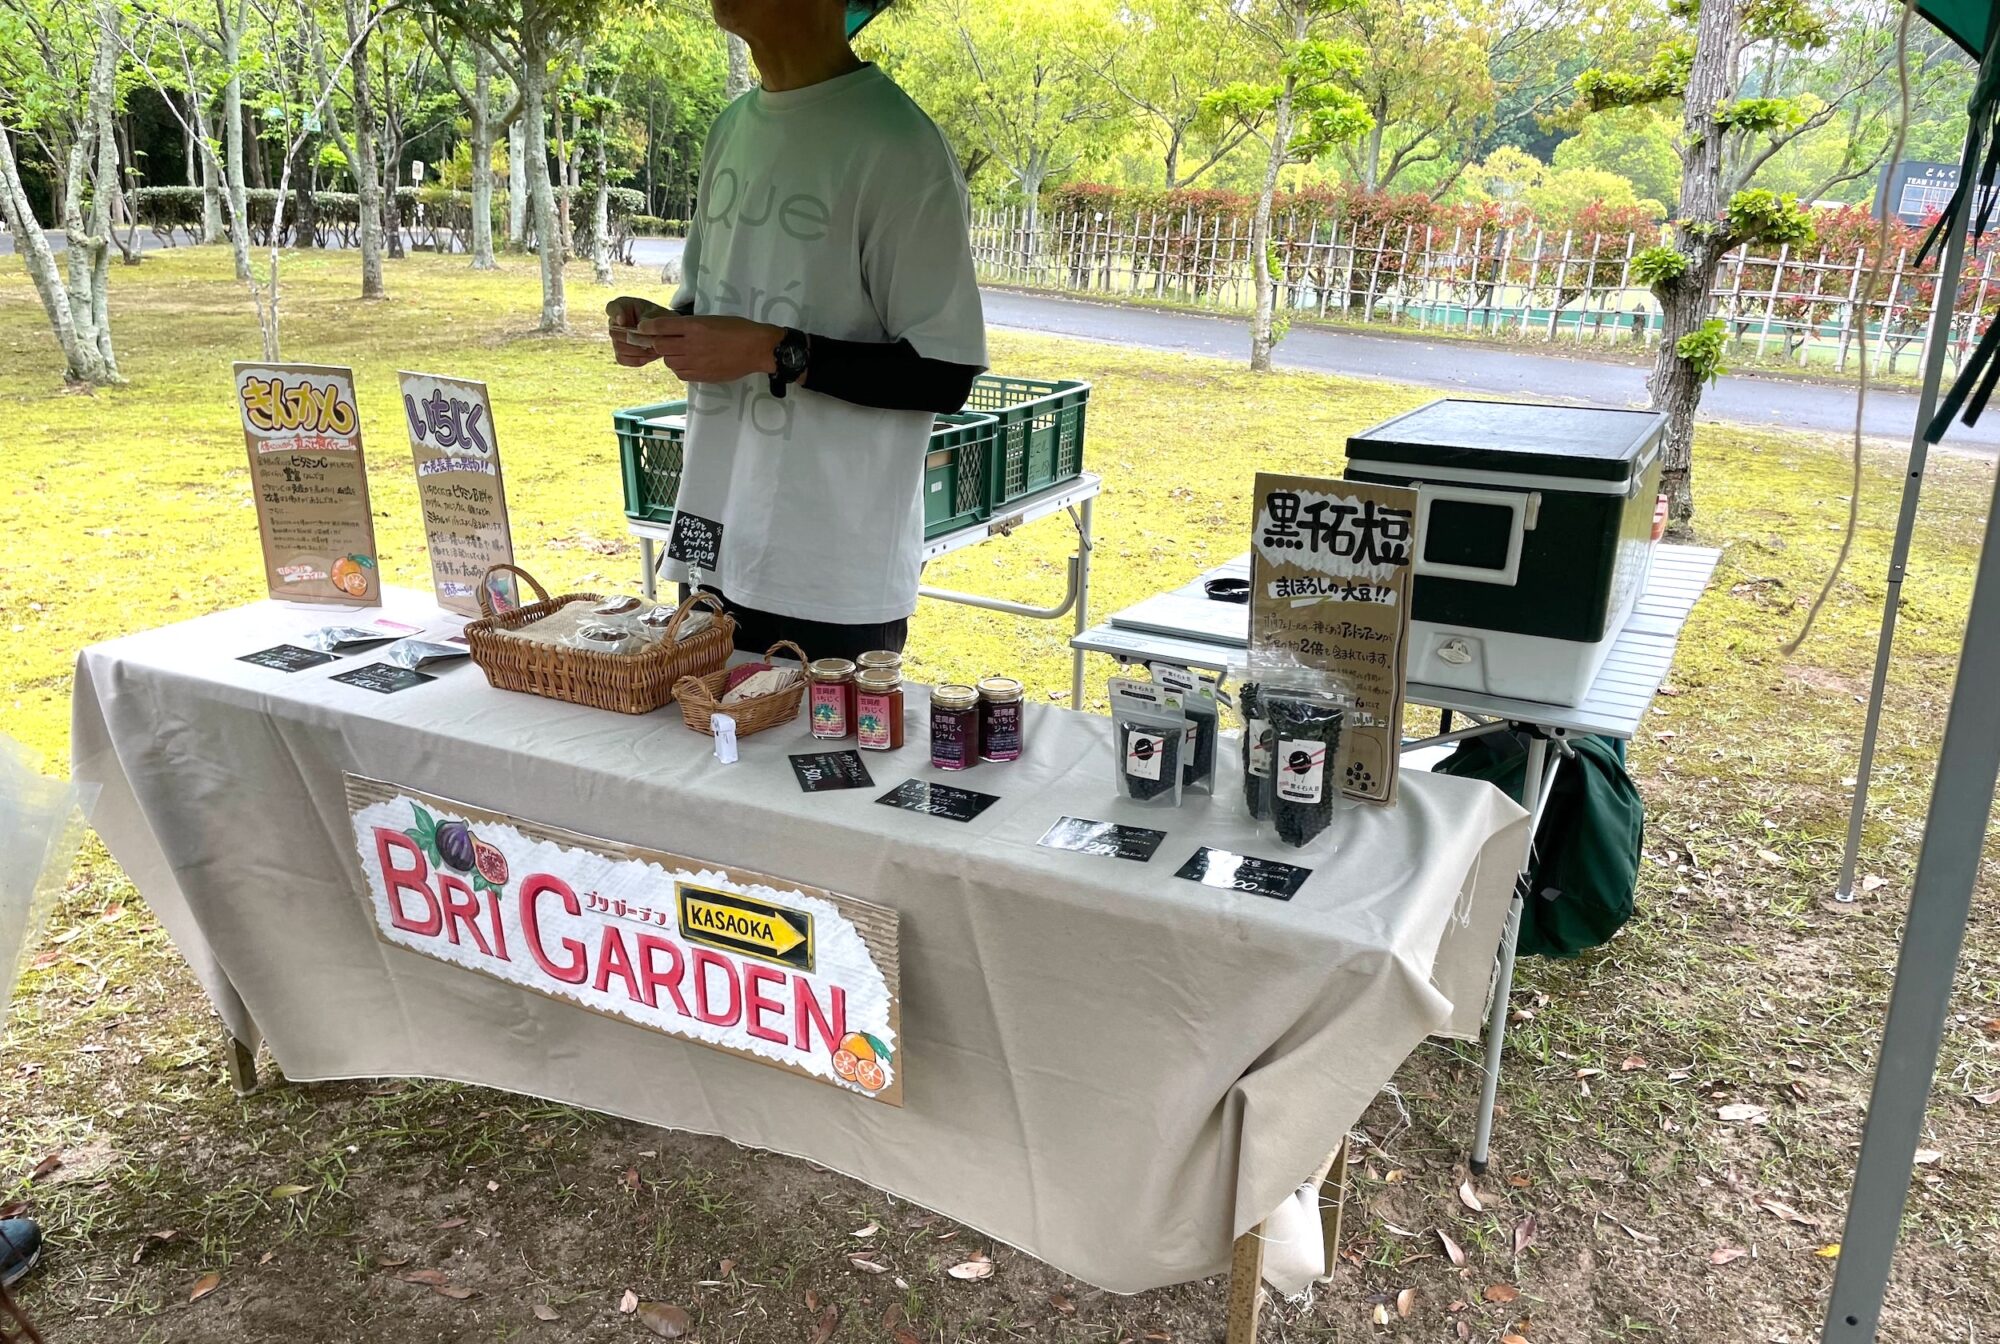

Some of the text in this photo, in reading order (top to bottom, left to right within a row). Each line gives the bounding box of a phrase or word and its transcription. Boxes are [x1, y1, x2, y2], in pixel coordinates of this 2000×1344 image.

[242, 376, 356, 435] きんかん
[405, 389, 487, 453] いちじく
[1264, 492, 1412, 566] 黒千石大豆
[685, 548, 715, 562] 200円
[1276, 576, 1391, 603] まぼろしの大豆!!
[993, 708, 1016, 717] 笠岡産
[994, 725, 1015, 733] ジャム
[935, 731, 956, 741] ジャム
[584, 891, 667, 926] ブリガーデン
[691, 905, 775, 942] KASAOKA
[372, 826, 848, 1056] BRI GARDEN
